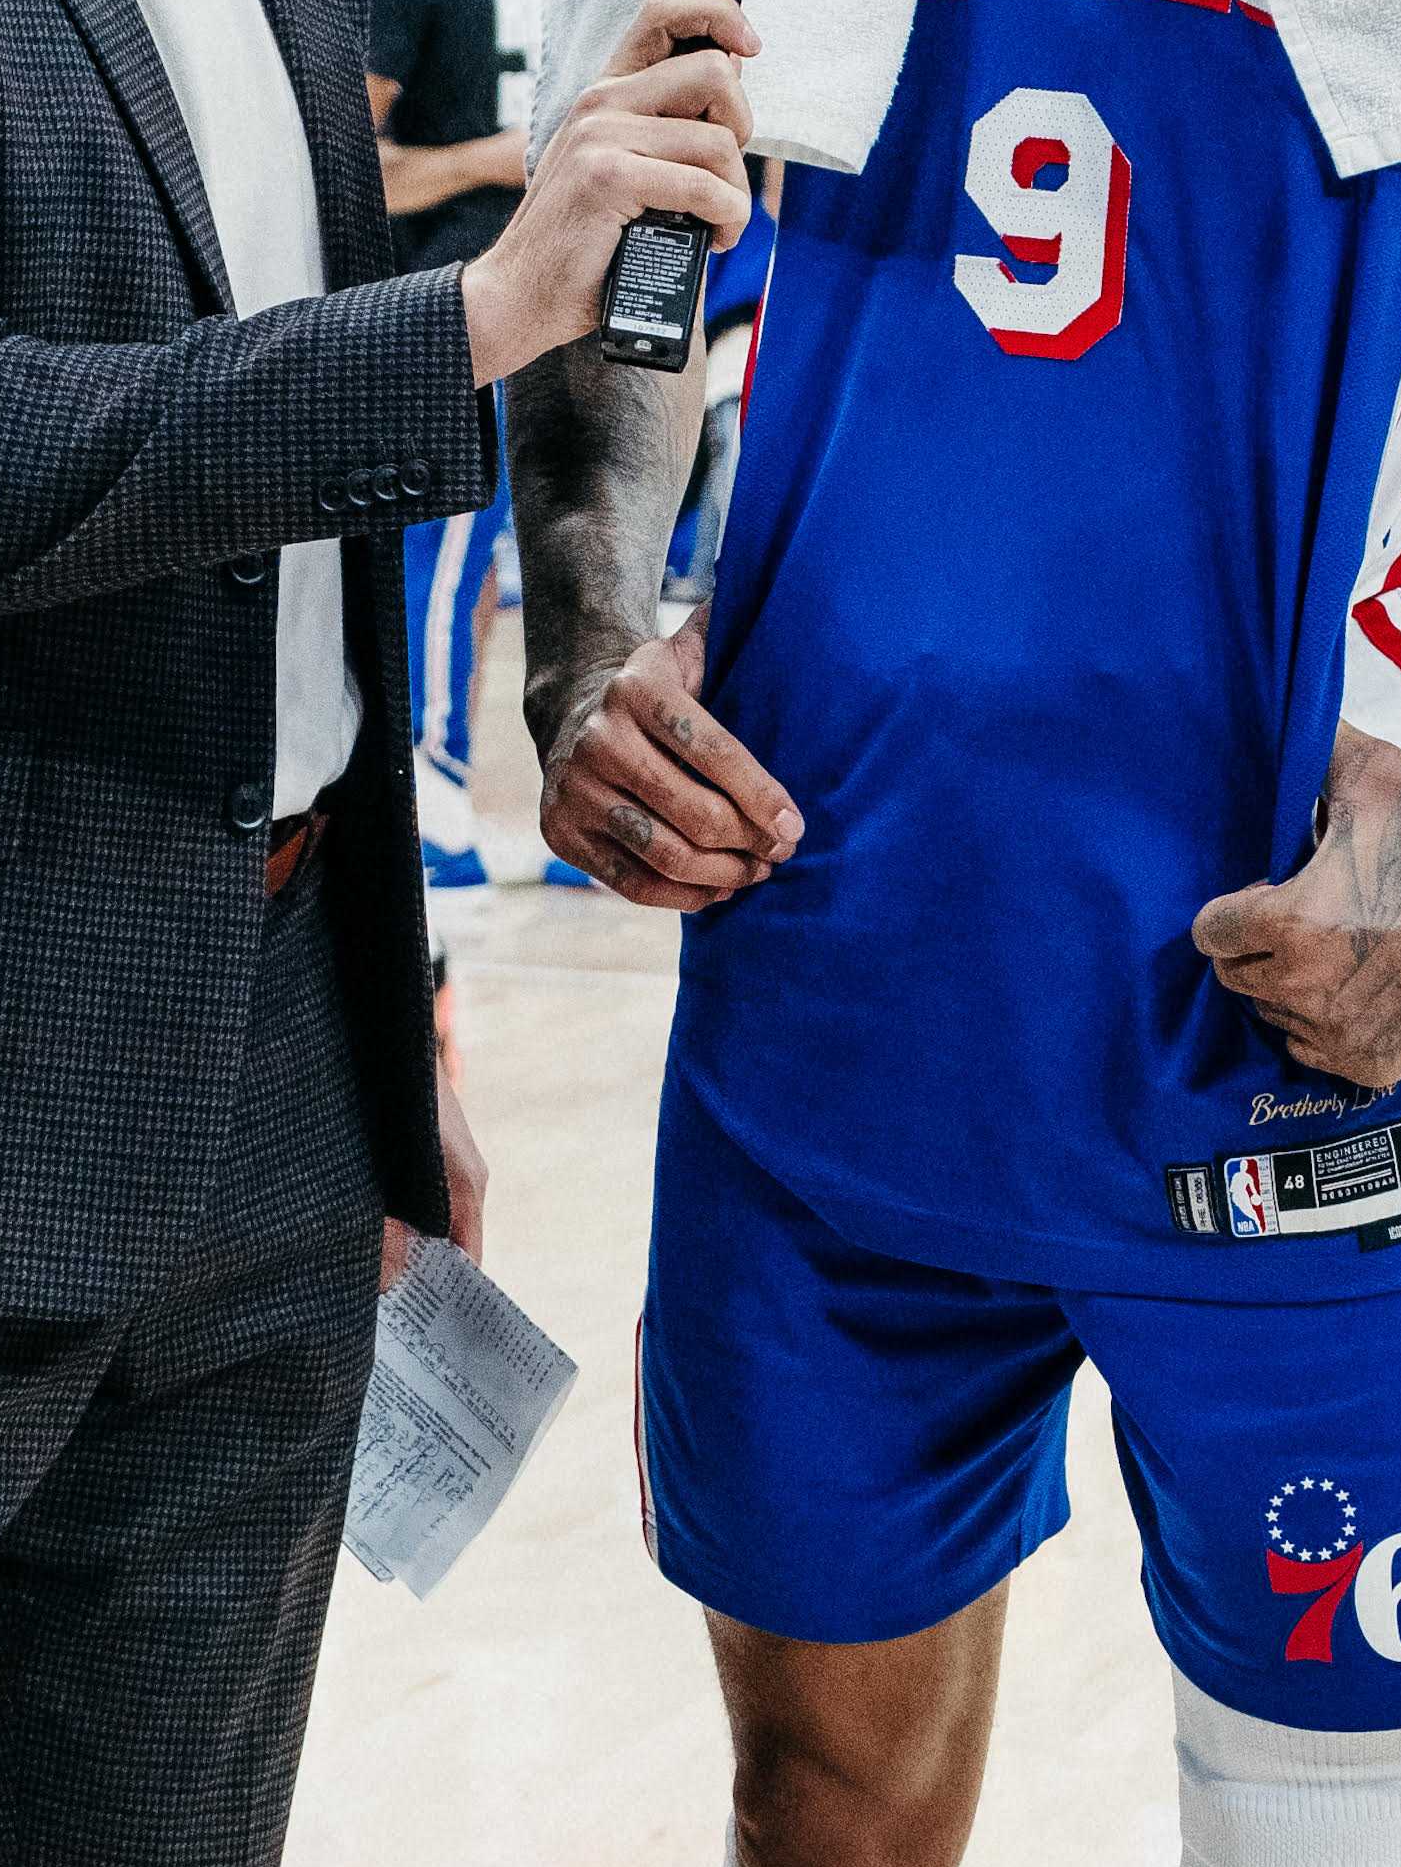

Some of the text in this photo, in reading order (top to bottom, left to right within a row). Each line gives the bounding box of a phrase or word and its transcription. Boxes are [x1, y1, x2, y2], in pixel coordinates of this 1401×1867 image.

[953, 87, 1131, 360] 9
[1249, 1092, 1348, 1126] Brotherly
[1316, 1136, 1388, 1163] ENGINEERED
[1283, 1174, 1305, 1191] 48
[1236, 1220, 1255, 1232] NBA
